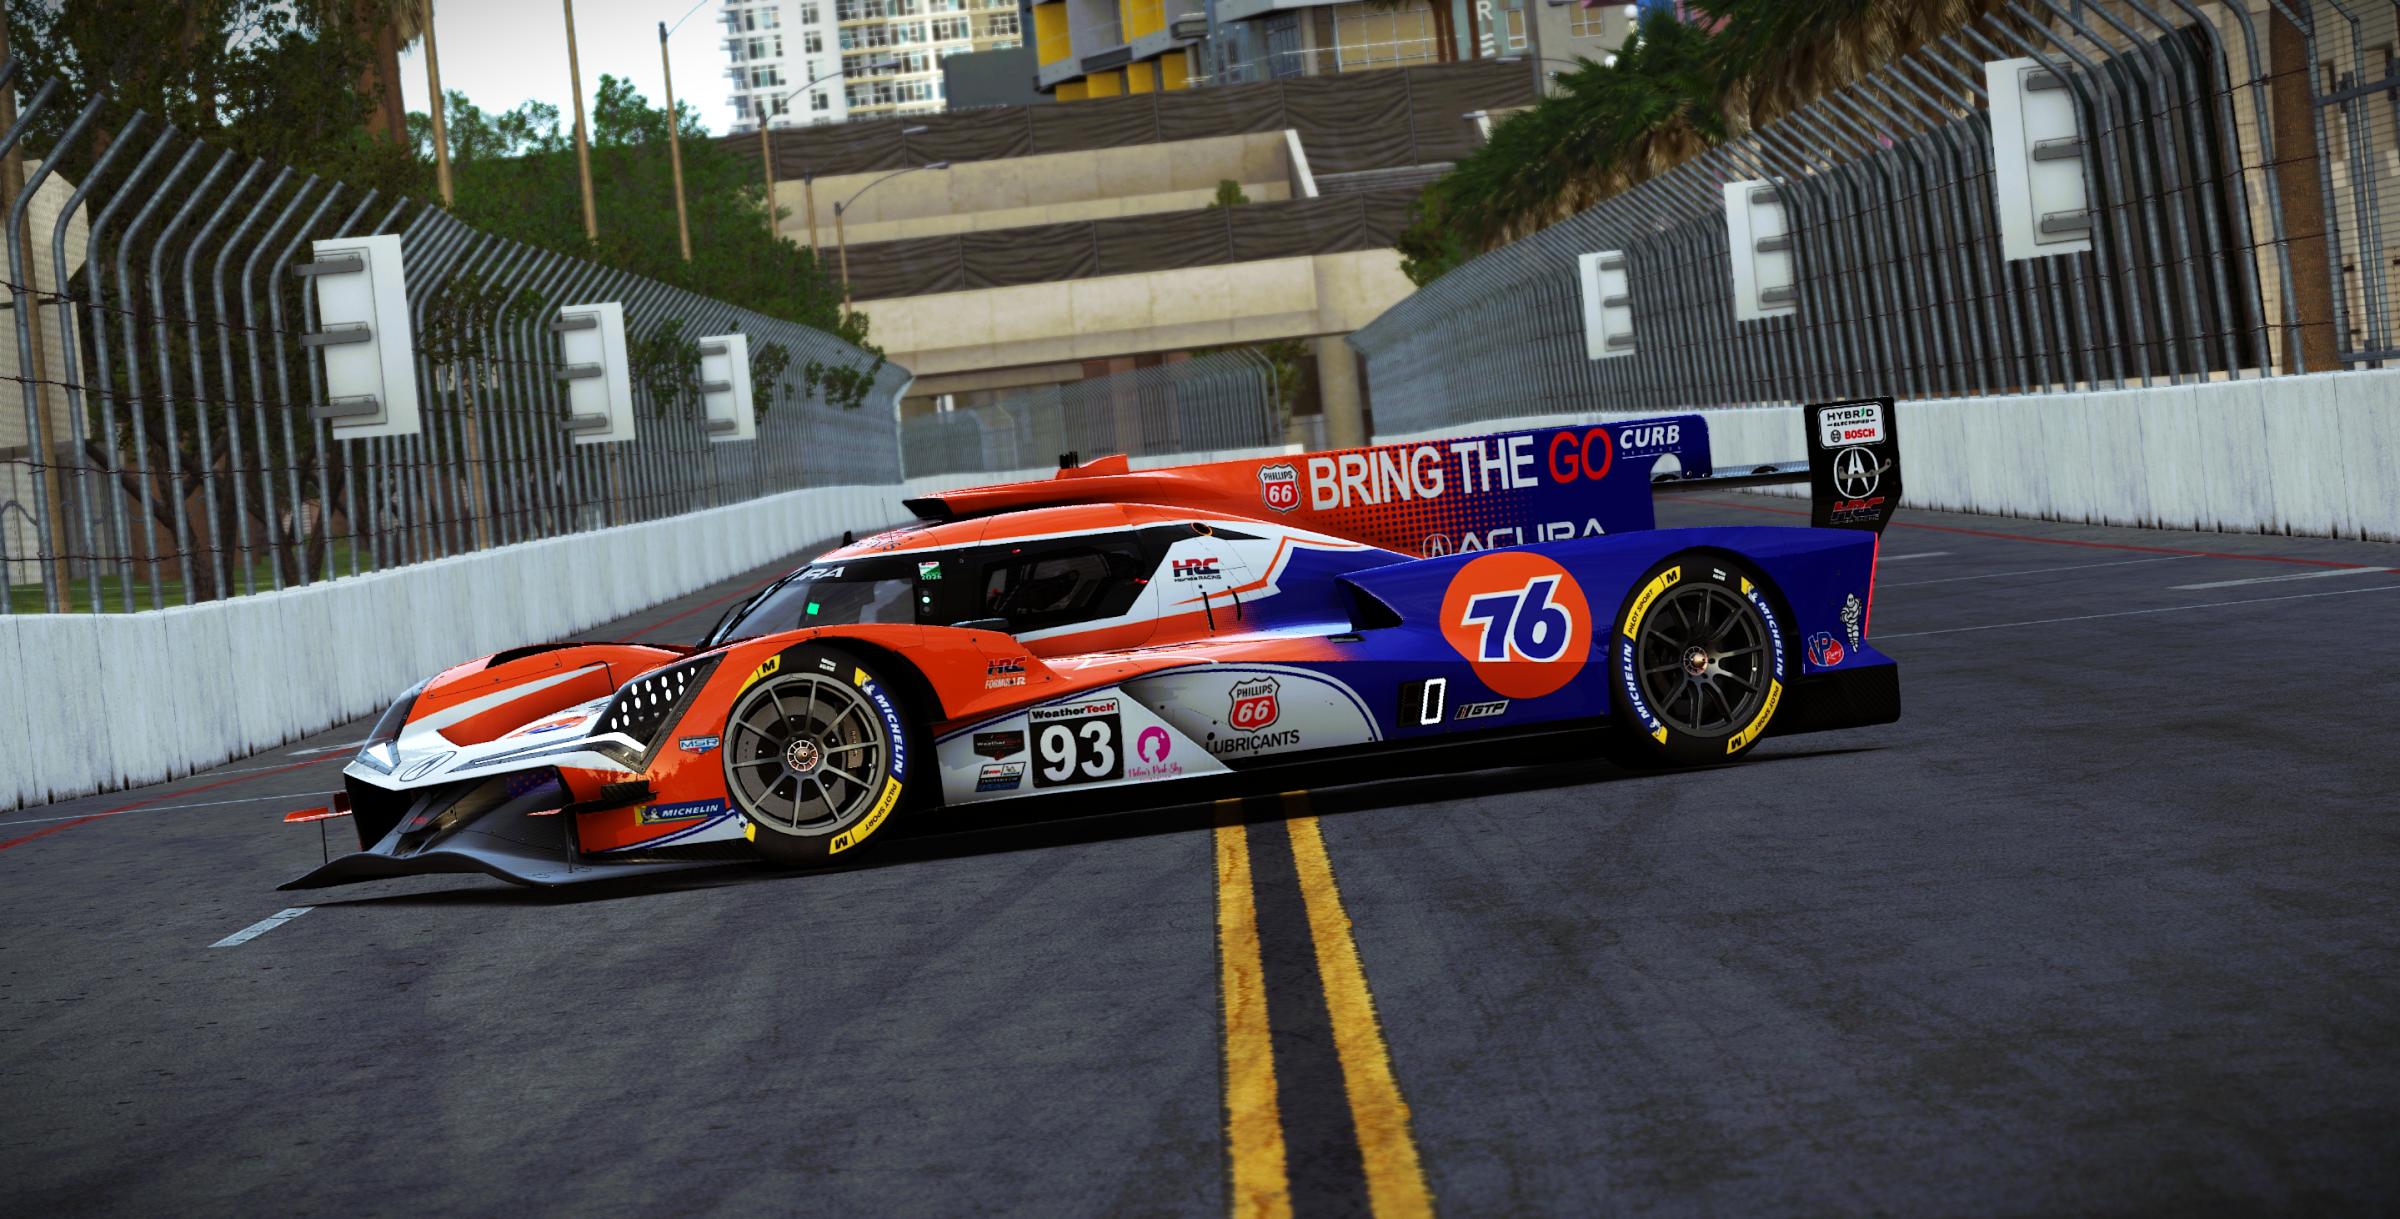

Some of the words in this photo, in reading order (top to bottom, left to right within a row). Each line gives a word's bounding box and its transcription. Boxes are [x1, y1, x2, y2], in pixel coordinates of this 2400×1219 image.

[1620, 425, 1680, 449] CURB
[1844, 428, 1875, 440] BOSCH
[1264, 470, 1293, 481] PHILLIPS
[1307, 445, 1445, 511] BRING
[1451, 435, 1538, 494] THE
[1549, 427, 1613, 484] GO
[1269, 484, 1292, 503] 66
[1172, 557, 1219, 577] HRC
[1666, 570, 1677, 583] M
[1460, 574, 1572, 662] 76
[1628, 611, 1638, 634] PILOT
[1637, 589, 1653, 612] SPORT
[1758, 602, 1783, 676] MICHELIN
[762, 659, 776, 673] M
[987, 656, 1027, 675] HRC
[1624, 643, 1650, 719] MICHELIN
[1236, 684, 1273, 698] PHILLIPS
[1032, 702, 1115, 719] WeatherTech
[1238, 700, 1270, 723] 66
[1471, 702, 1506, 715] GTP
[681, 738, 718, 748] MSR
[874, 695, 903, 774] MICHELIN
[1731, 735, 1742, 749] M
[1040, 720, 1115, 781] 93
[884, 783, 898, 808] PILOT
[662, 804, 718, 818] MICHELIN
[865, 806, 886, 831] SPORT
[834, 836, 848, 849] M
